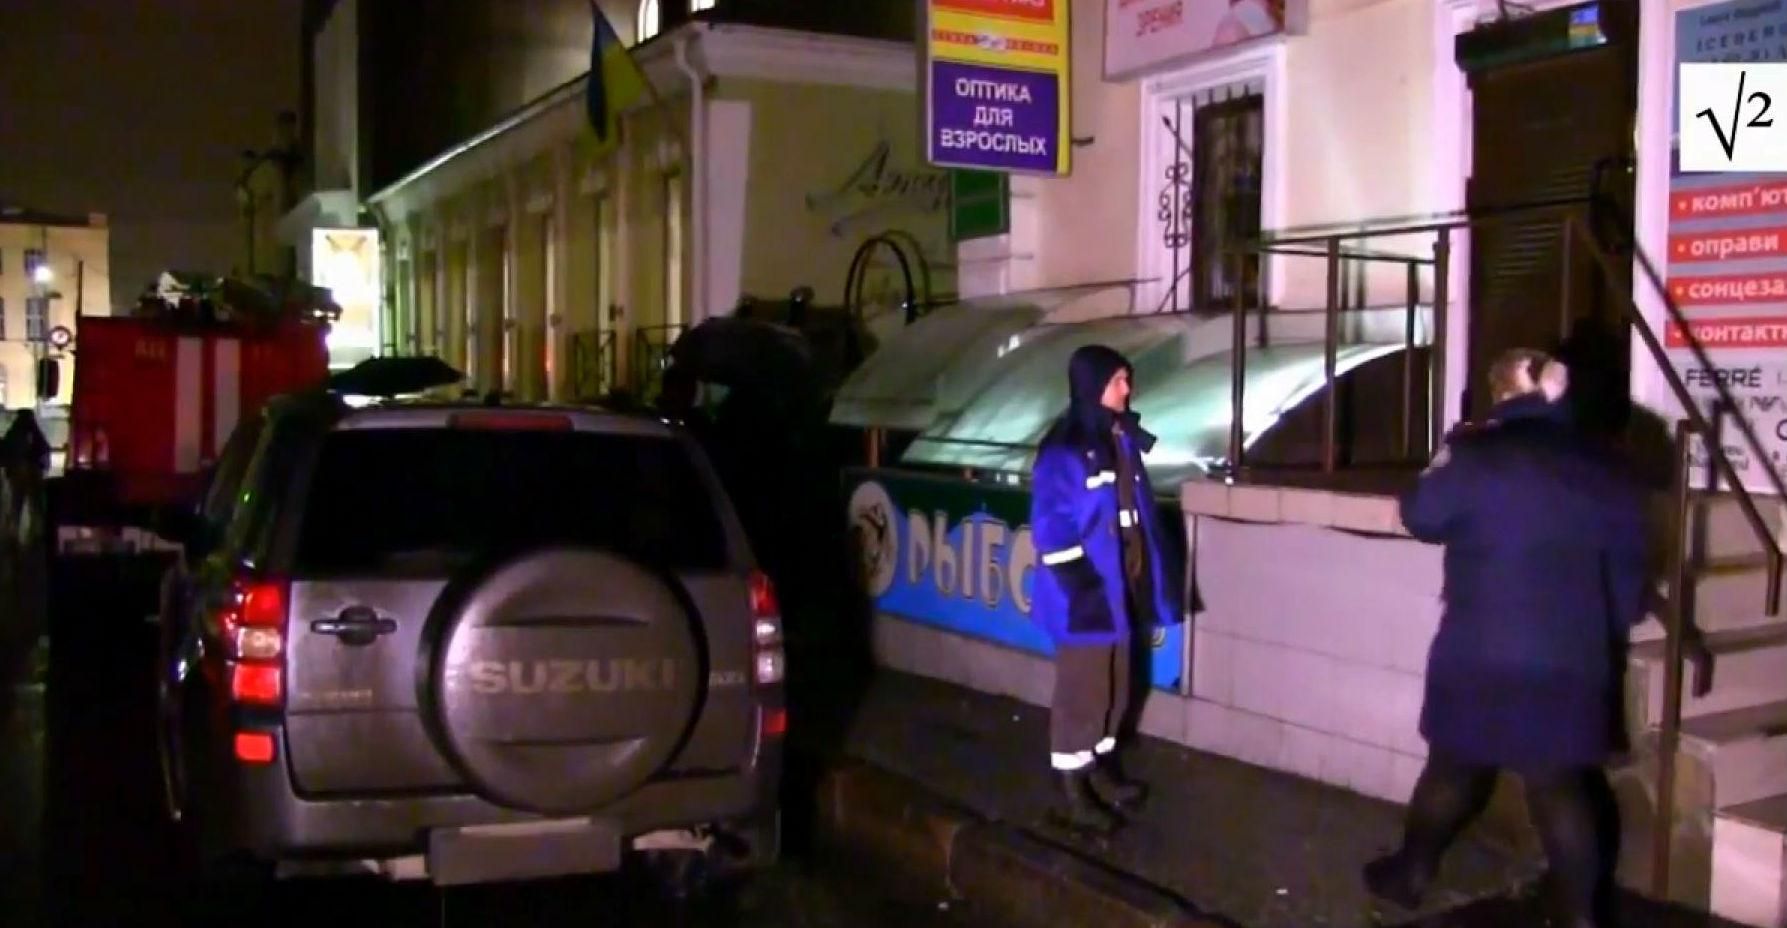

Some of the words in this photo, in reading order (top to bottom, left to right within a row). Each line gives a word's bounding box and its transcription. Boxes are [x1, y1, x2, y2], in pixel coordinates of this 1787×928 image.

[955, 77, 1031, 104] ОПТИКА
[973, 105, 1014, 127] ДЛЯ
[940, 128, 1047, 156] ВЗРОСЛЫХ
[1690, 234, 1779, 259] оправи
[470, 657, 678, 694] SUZUKI
